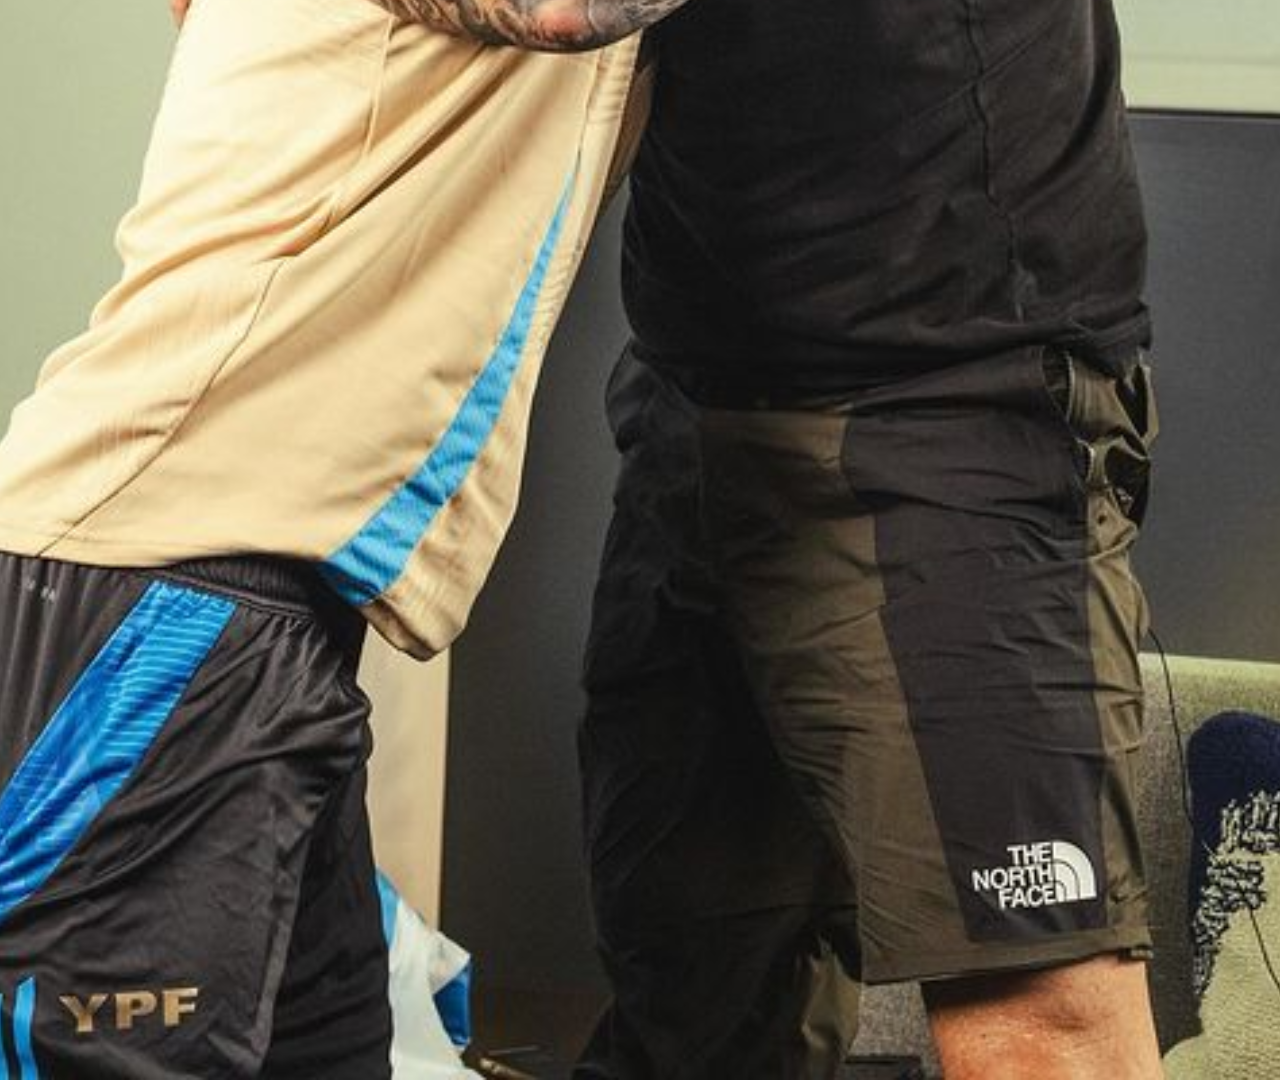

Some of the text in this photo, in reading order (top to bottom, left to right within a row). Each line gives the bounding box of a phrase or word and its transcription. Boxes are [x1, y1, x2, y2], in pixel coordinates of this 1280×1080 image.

[1006, 841, 1052, 866] THE
[971, 863, 1054, 892] NORTH
[997, 884, 1056, 910] FACE
[58, 987, 199, 1033] YPF
